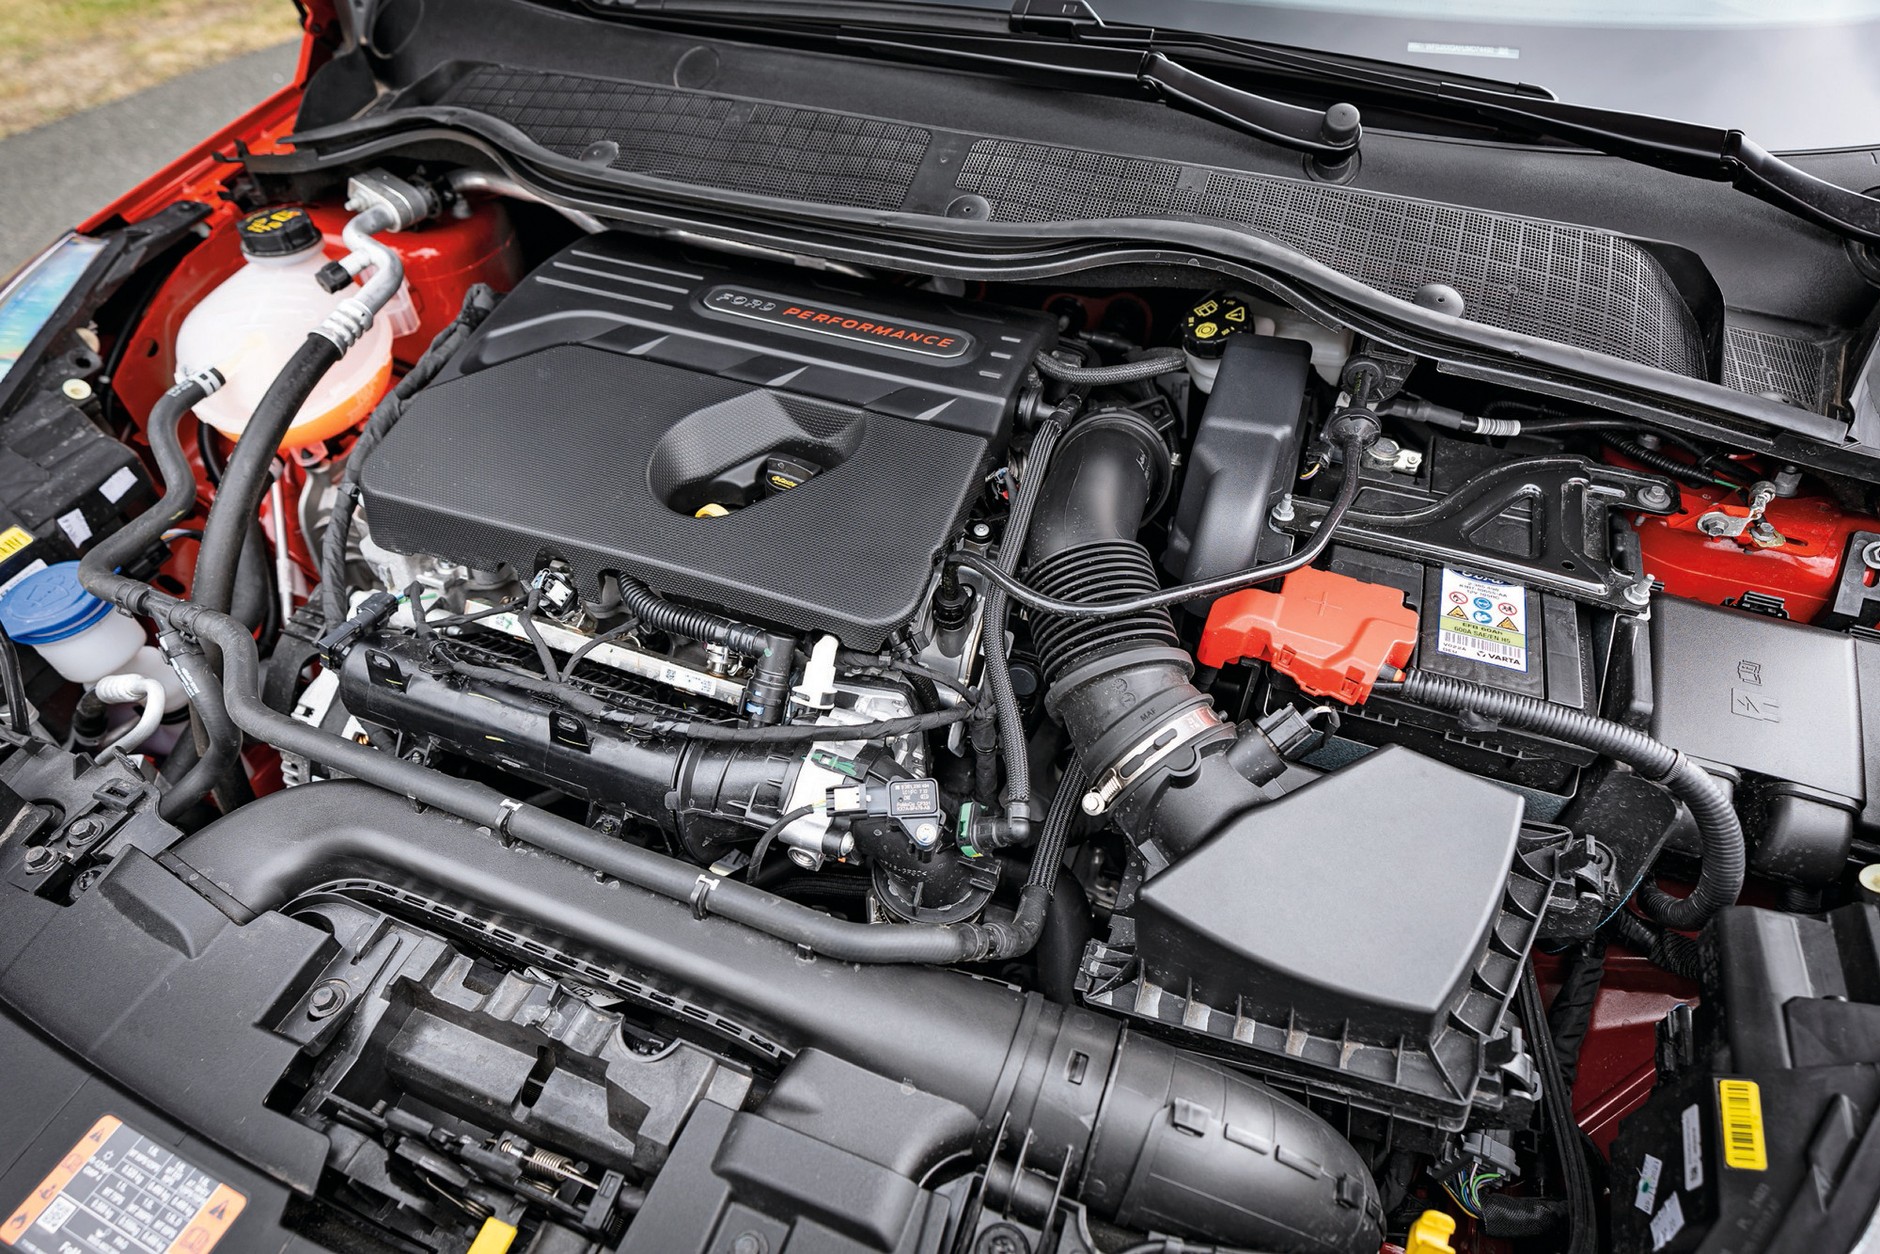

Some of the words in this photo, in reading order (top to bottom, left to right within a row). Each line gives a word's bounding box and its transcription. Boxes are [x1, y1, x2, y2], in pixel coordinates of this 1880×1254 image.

[715, 292, 777, 312] FORD
[782, 306, 955, 349] PERFORMANCE
[1488, 653, 1521, 665] VARTA
[1140, 707, 1157, 721] MAF
